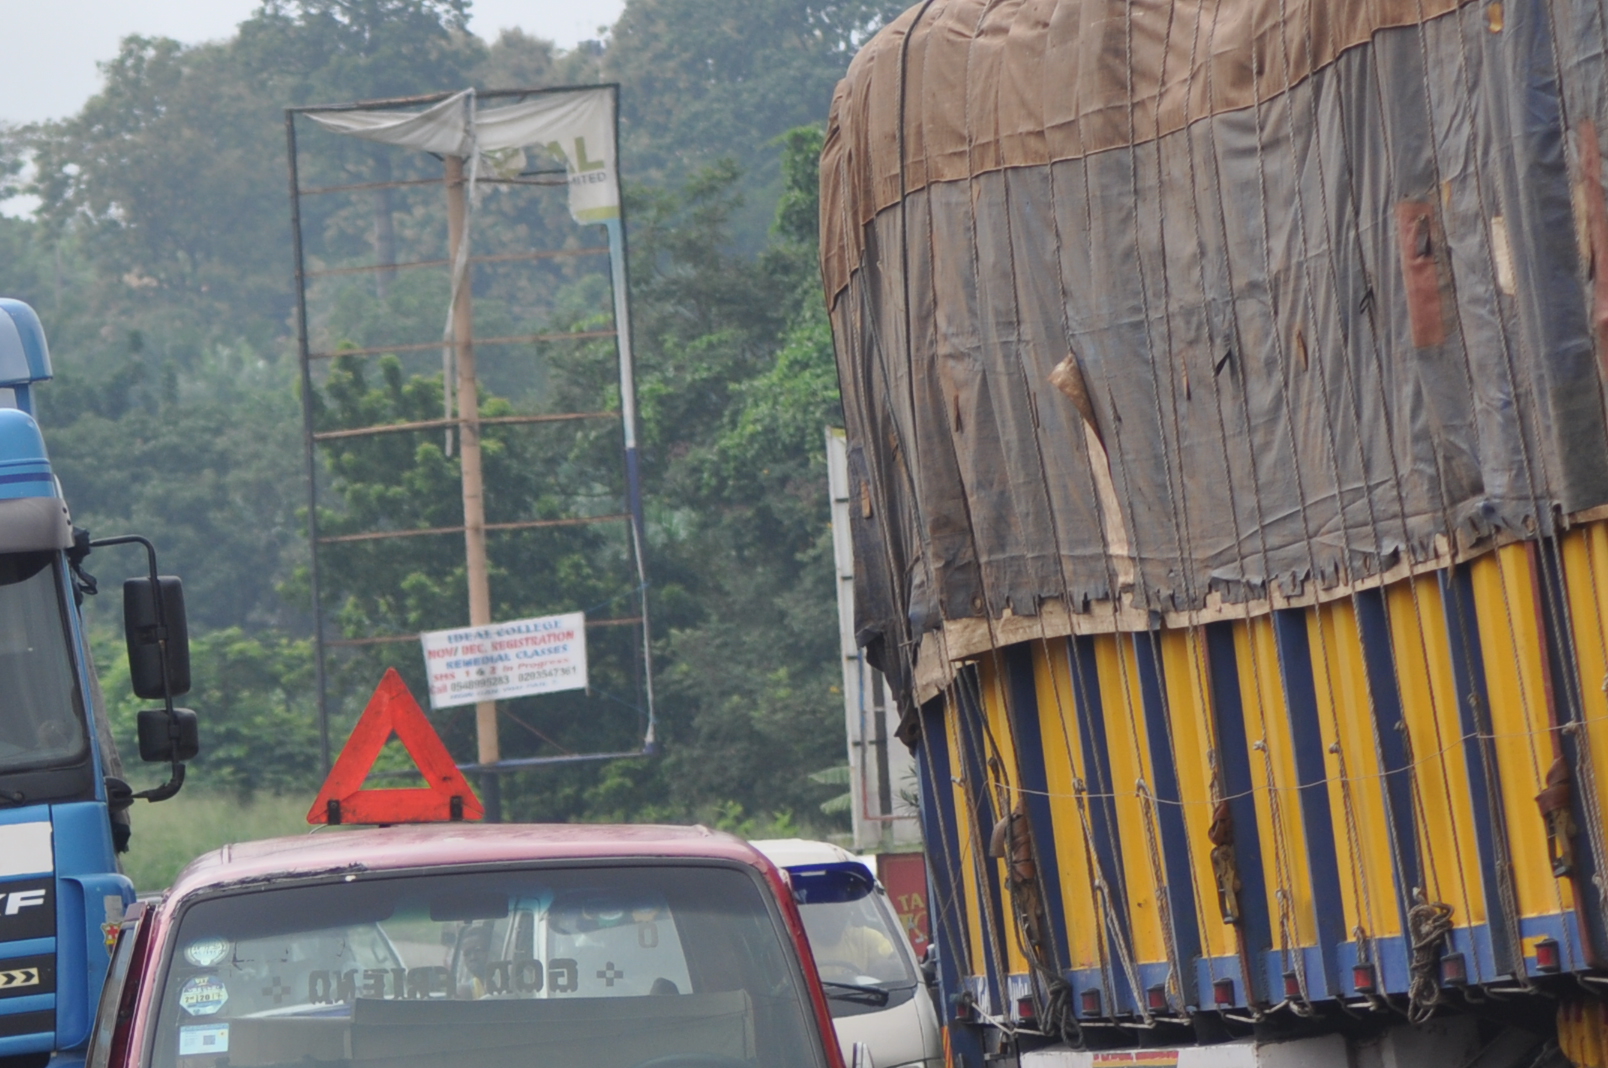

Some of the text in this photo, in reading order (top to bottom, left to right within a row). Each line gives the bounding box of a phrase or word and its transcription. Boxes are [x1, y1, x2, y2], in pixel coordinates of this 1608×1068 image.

[448, 619, 562, 644] IDEAL COLLEGE
[492, 630, 575, 651] REGISTRATION
[446, 644, 568, 669] REMEDIAL CLASSES
